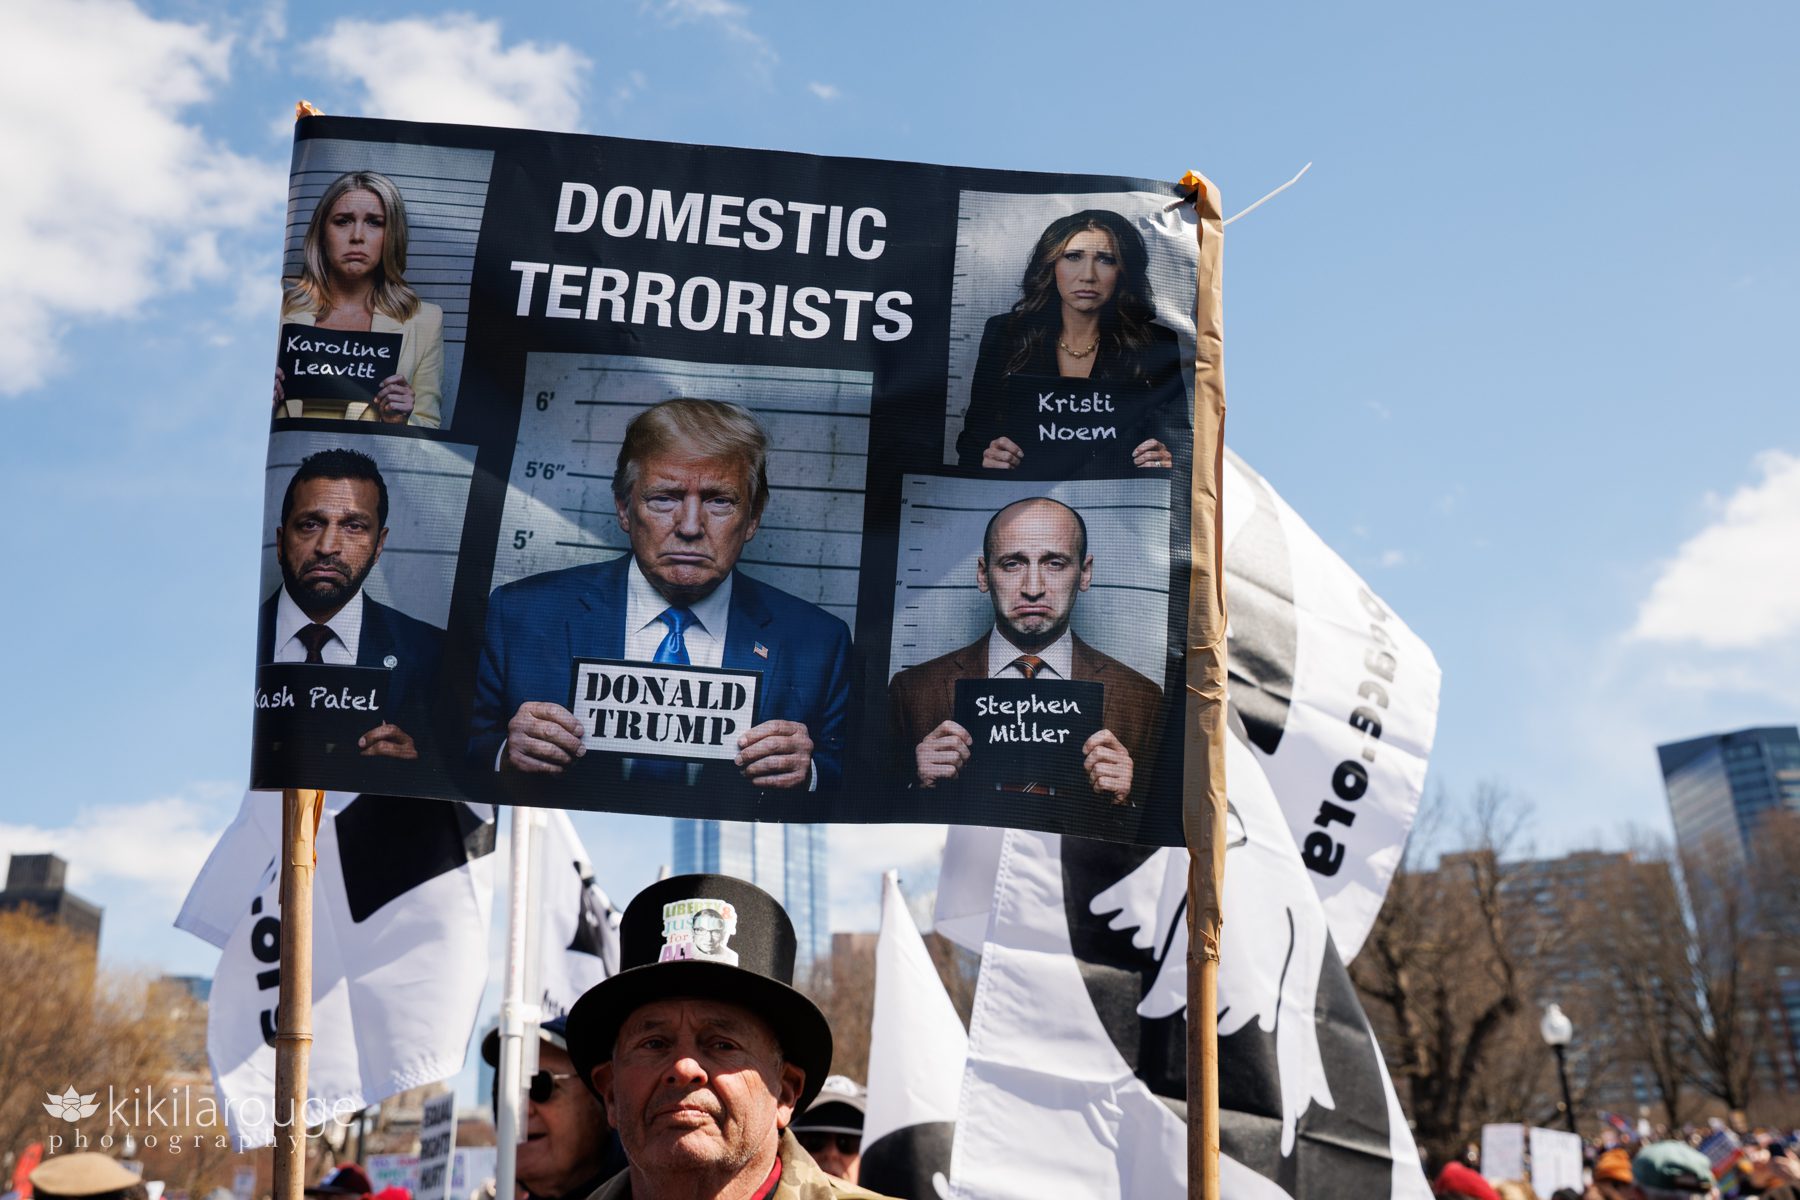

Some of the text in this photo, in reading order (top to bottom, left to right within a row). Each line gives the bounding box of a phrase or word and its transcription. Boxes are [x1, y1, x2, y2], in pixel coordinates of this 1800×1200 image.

[555, 182, 887, 260] DOMESTIC
[511, 261, 913, 342] TERRORISTS
[286, 335, 391, 361] Karoline
[294, 358, 376, 379] Leavitt
[1038, 391, 1115, 414] Kristi
[1038, 422, 1117, 442] Noem
[309, 687, 380, 711] Patel
[586, 672, 747, 712] DONALD
[975, 693, 1081, 725] Stephen
[589, 707, 737, 746] TRUMP
[988, 722, 1071, 745] Miller
[669, 933, 689, 944] for
